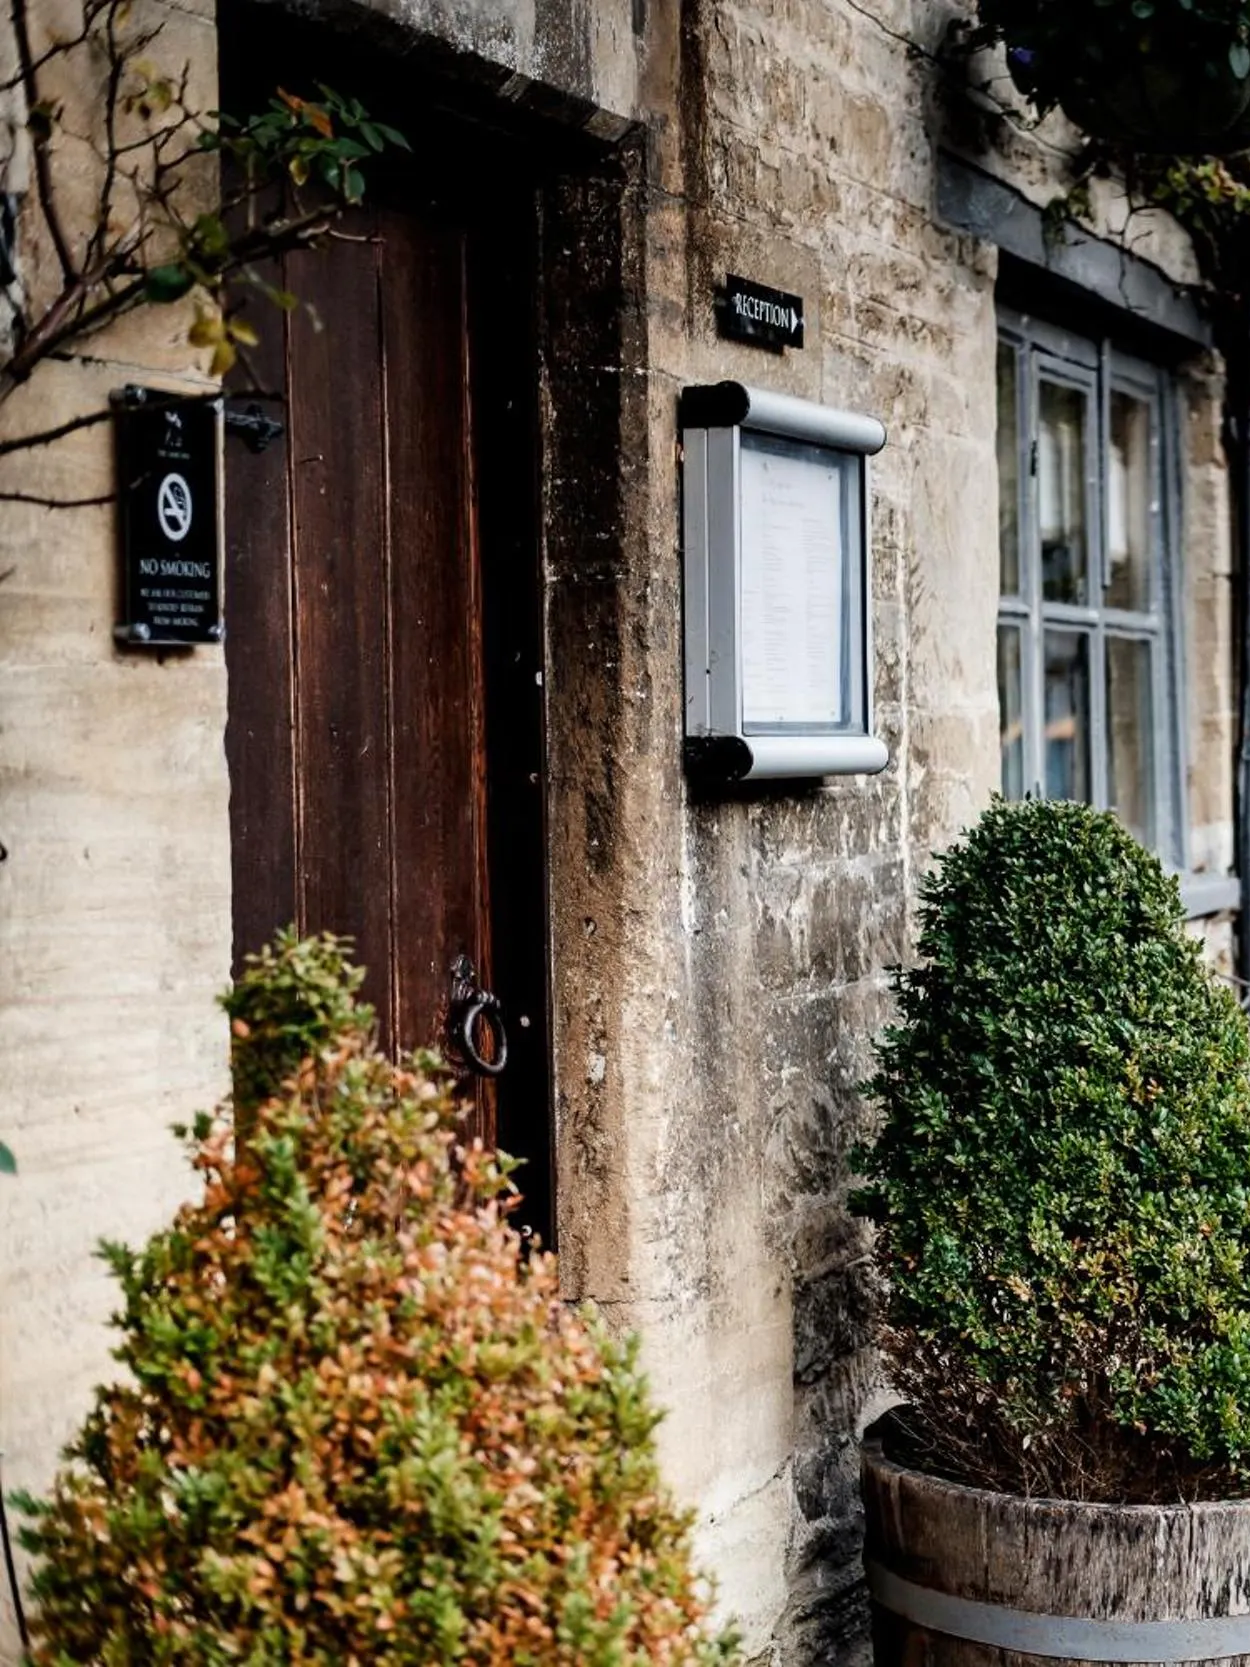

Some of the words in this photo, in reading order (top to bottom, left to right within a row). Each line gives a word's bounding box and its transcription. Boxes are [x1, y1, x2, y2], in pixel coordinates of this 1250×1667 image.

[736, 293, 789, 328] RECEPTION
[140, 558, 158, 576] NO
[160, 559, 210, 579] SMOKING
